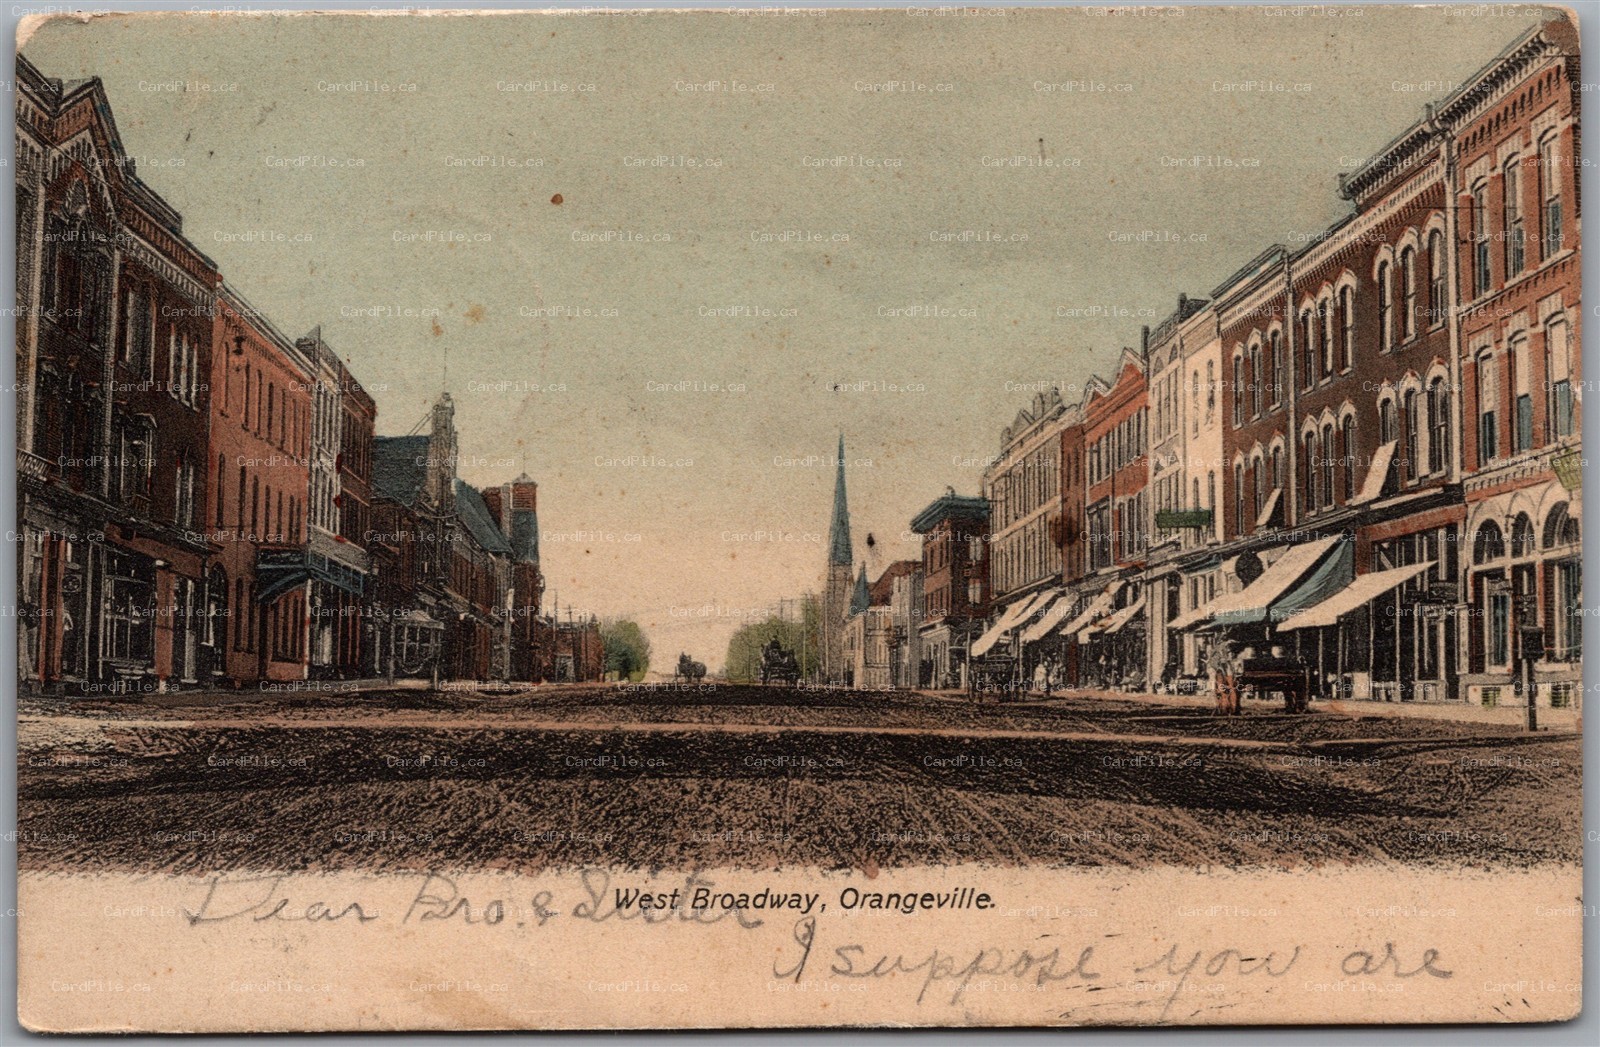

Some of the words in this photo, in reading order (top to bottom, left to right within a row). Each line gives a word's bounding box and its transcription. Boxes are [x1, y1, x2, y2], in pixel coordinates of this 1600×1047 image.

[184, 875, 379, 926] Dear
[614, 887, 681, 911] West
[691, 887, 828, 914] Broadway,
[839, 886, 997, 914] Orangeville.
[831, 945, 1101, 1005] suppose
[1134, 943, 1301, 1021] you
[1341, 943, 1453, 978] are
